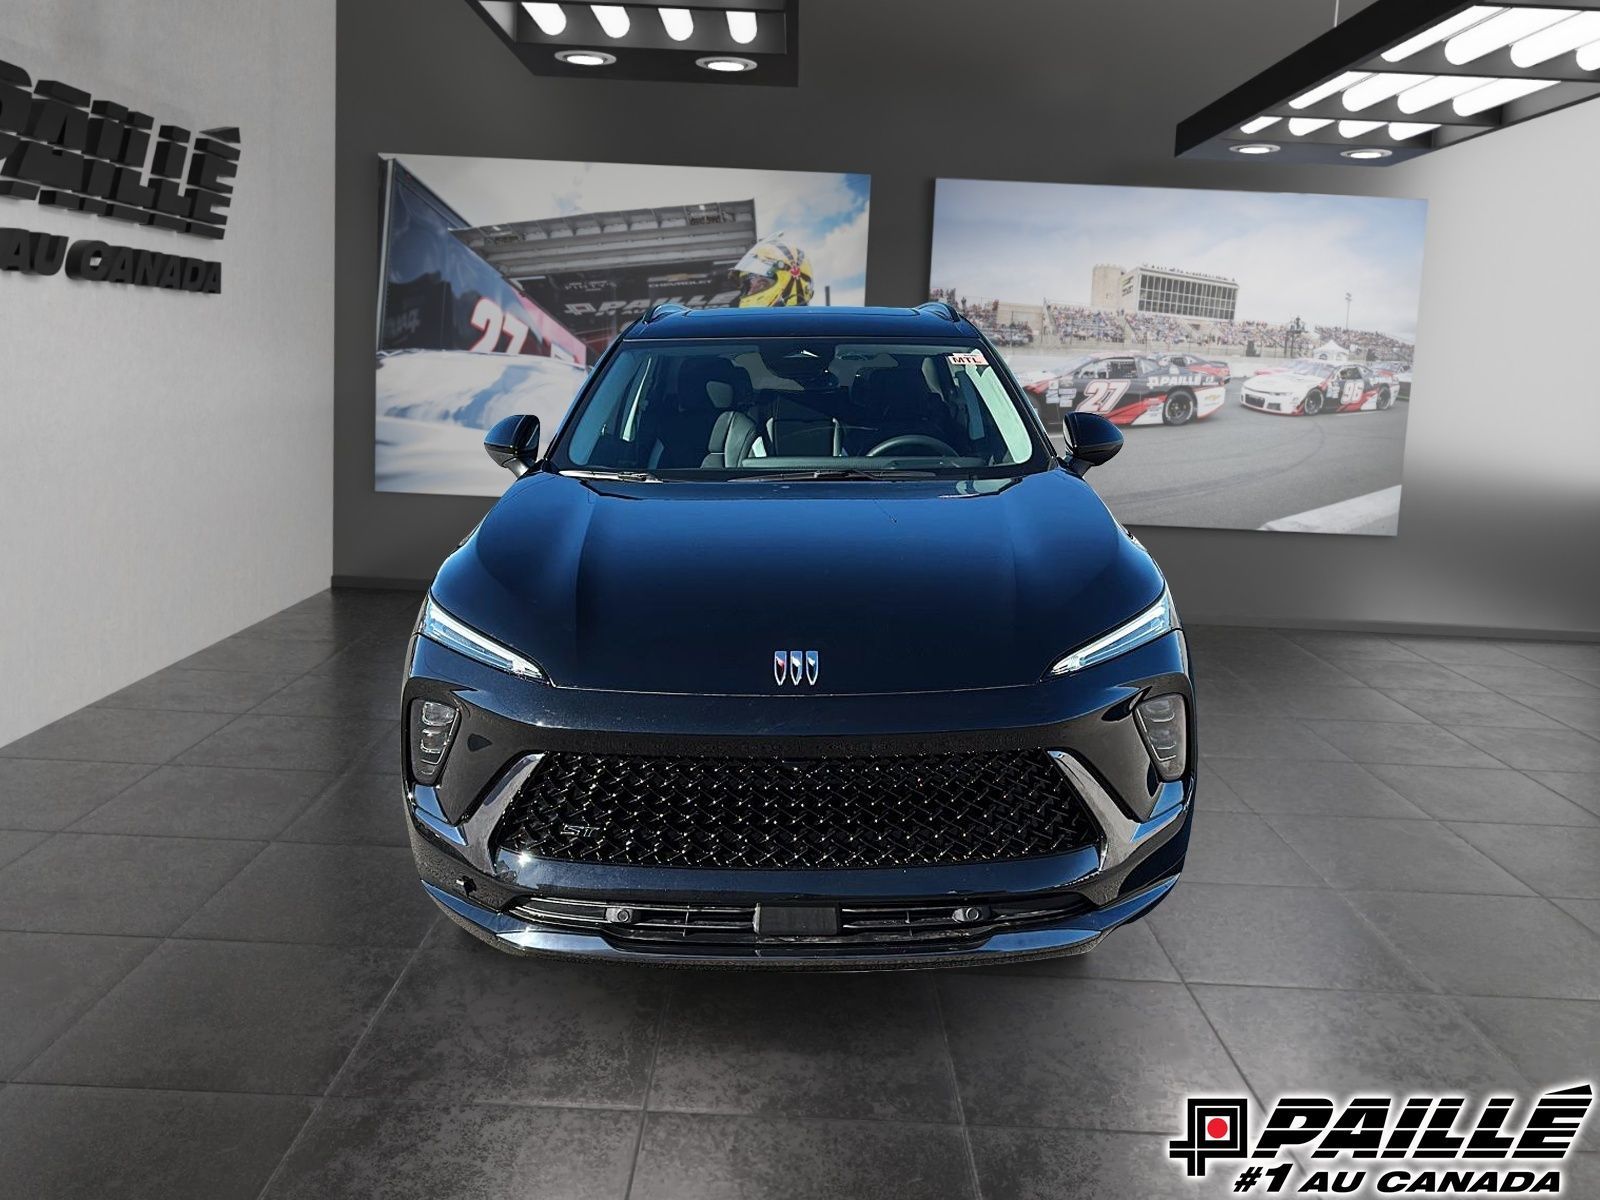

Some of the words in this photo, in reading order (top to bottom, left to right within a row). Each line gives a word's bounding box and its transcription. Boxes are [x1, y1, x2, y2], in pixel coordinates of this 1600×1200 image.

[65, 239, 222, 294] CANADA
[469, 297, 529, 354] 27
[952, 356, 983, 364] MTL
[1076, 379, 1131, 414] 27
